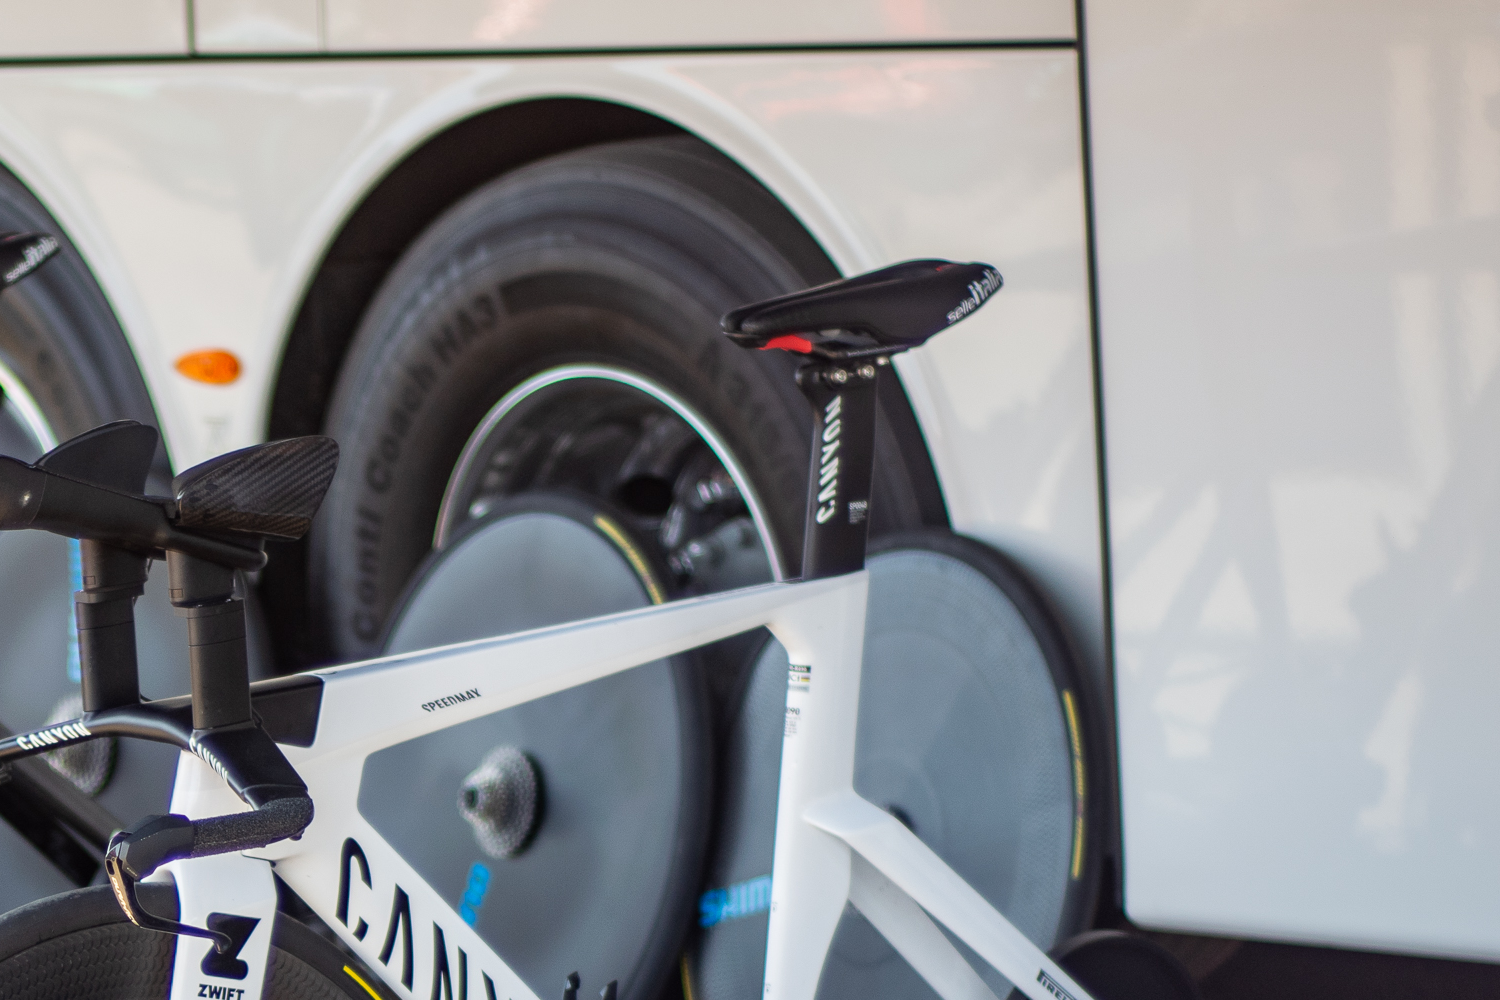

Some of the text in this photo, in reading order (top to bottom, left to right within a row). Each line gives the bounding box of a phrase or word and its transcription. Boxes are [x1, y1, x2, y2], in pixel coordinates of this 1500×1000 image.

[946, 267, 1004, 325] selle italia
[815, 396, 842, 525] CANYON
[421, 687, 482, 713] SPEEDMAX
[16, 722, 92, 751] CANYON
